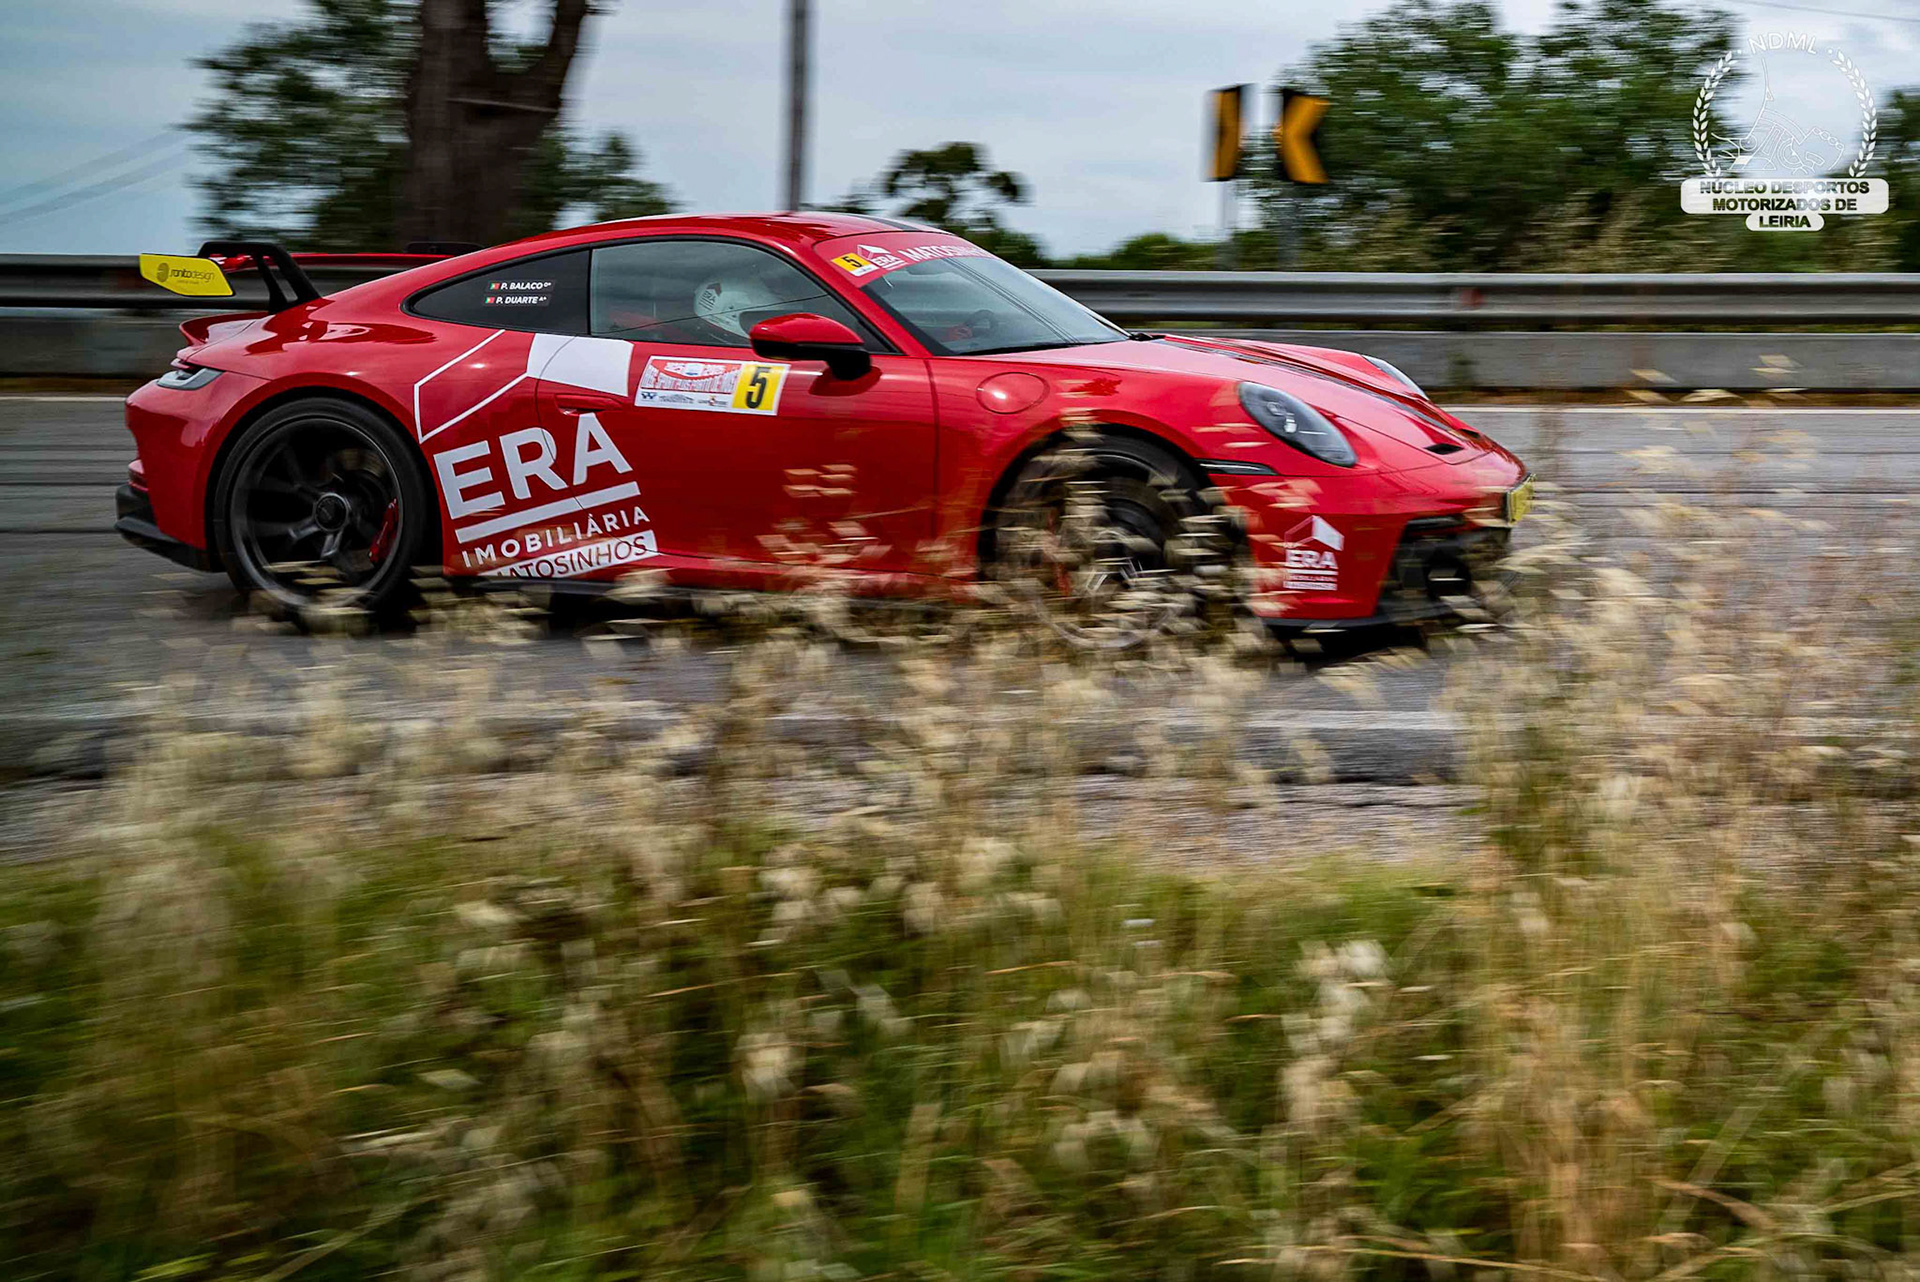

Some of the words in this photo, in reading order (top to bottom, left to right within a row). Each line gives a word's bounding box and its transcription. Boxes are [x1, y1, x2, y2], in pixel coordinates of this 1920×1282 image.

[842, 256, 863, 267] 5
[500, 282, 508, 290] P.
[509, 282, 543, 290] BALACO
[495, 296, 504, 304] P.
[504, 296, 538, 304] DUARTE
[746, 366, 772, 409] 5
[433, 412, 633, 519] ERA
[461, 506, 650, 568] IMOBILIÁRIA
[1285, 549, 1339, 570] ERA
